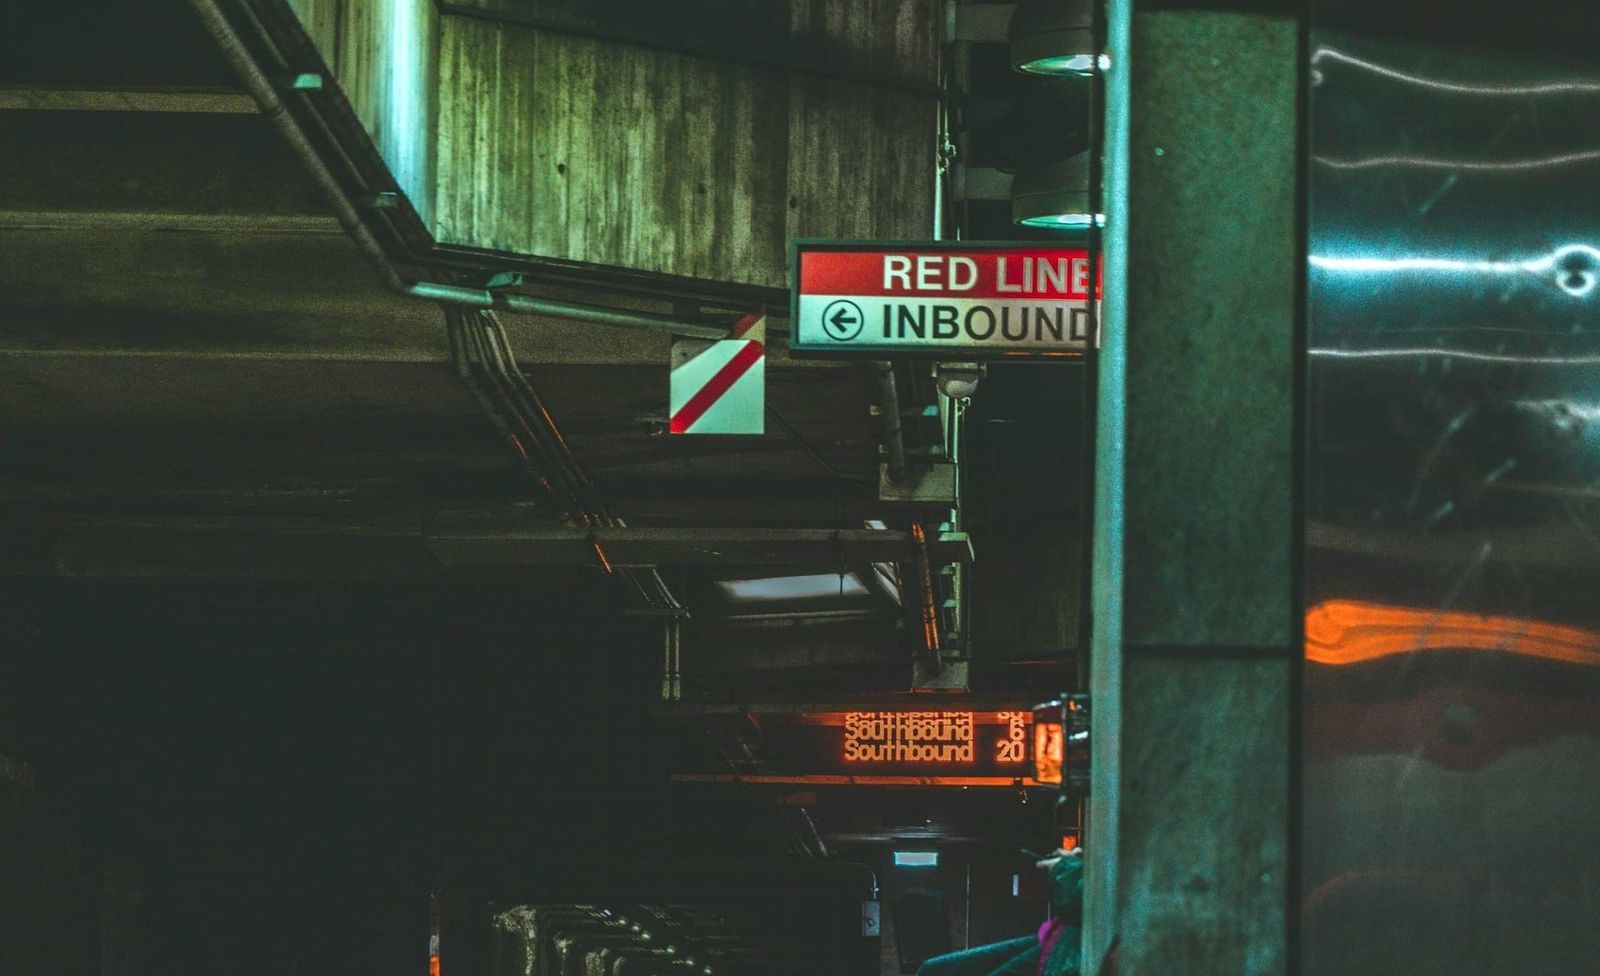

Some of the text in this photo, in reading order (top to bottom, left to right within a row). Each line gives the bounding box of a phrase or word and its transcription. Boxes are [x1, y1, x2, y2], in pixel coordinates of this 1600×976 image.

[883, 255, 1089, 293] RED LINE
[883, 304, 1089, 341] INBOUND
[845, 740, 1025, 762] Southbound 20
